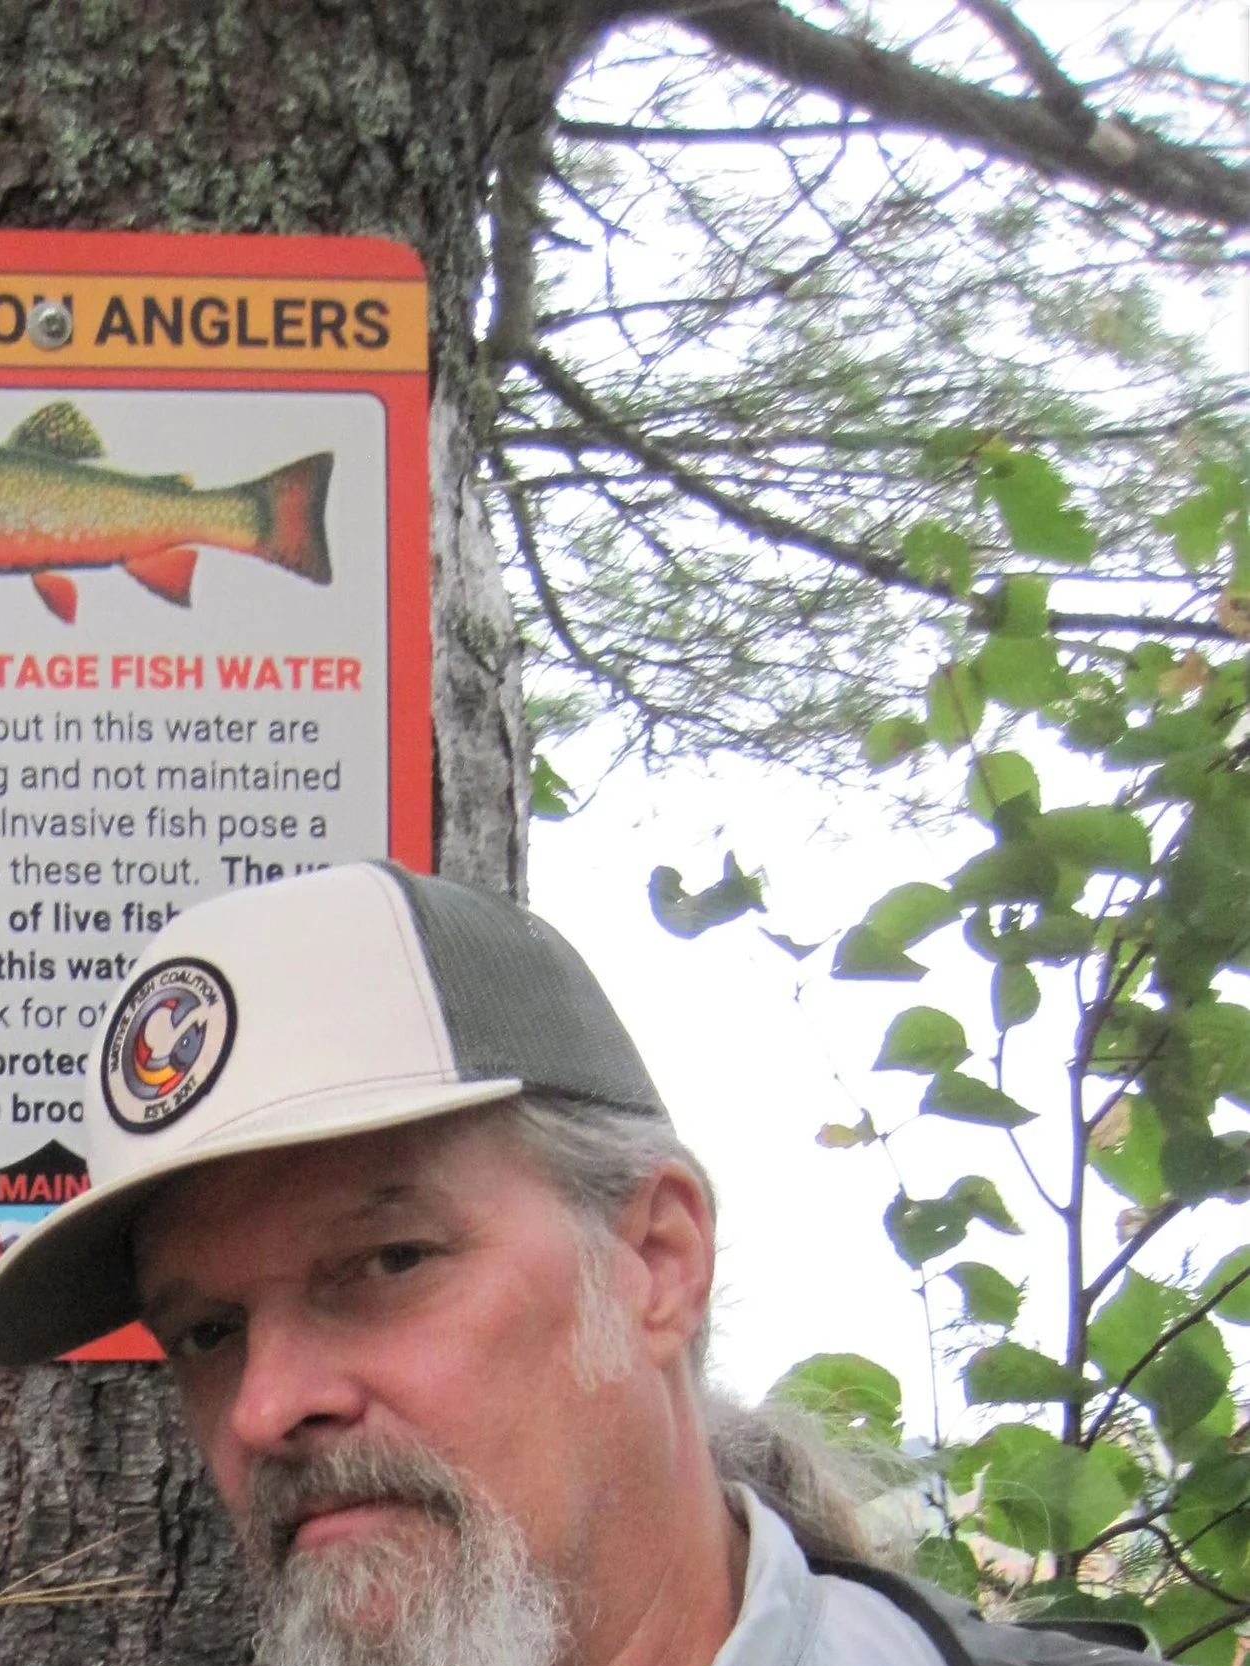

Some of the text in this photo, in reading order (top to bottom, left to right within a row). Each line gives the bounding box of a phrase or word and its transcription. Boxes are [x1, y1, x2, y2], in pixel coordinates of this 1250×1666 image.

[94, 294, 391, 351] ANGLERS
[111, 655, 204, 691] FISH
[217, 656, 362, 692] WATER
[55, 711, 83, 743] in
[92, 711, 154, 743] this
[164, 715, 258, 743] water
[268, 719, 319, 744] are
[20, 758, 81, 791] and
[93, 761, 147, 791] not
[157, 759, 341, 792] maintained
[1, 807, 136, 838] Invasive
[146, 805, 207, 838] fish
[218, 814, 298, 847] pose
[309, 814, 328, 839] a
[9, 853, 102, 886] these
[111, 856, 200, 886] trout.
[220, 854, 285, 887] The
[8, 900, 44, 934] of
[53, 901, 112, 934] live
[66, 952, 139, 982] wat
[159, 969, 219, 1007] COALITION
[20, 996, 68, 1030] for
